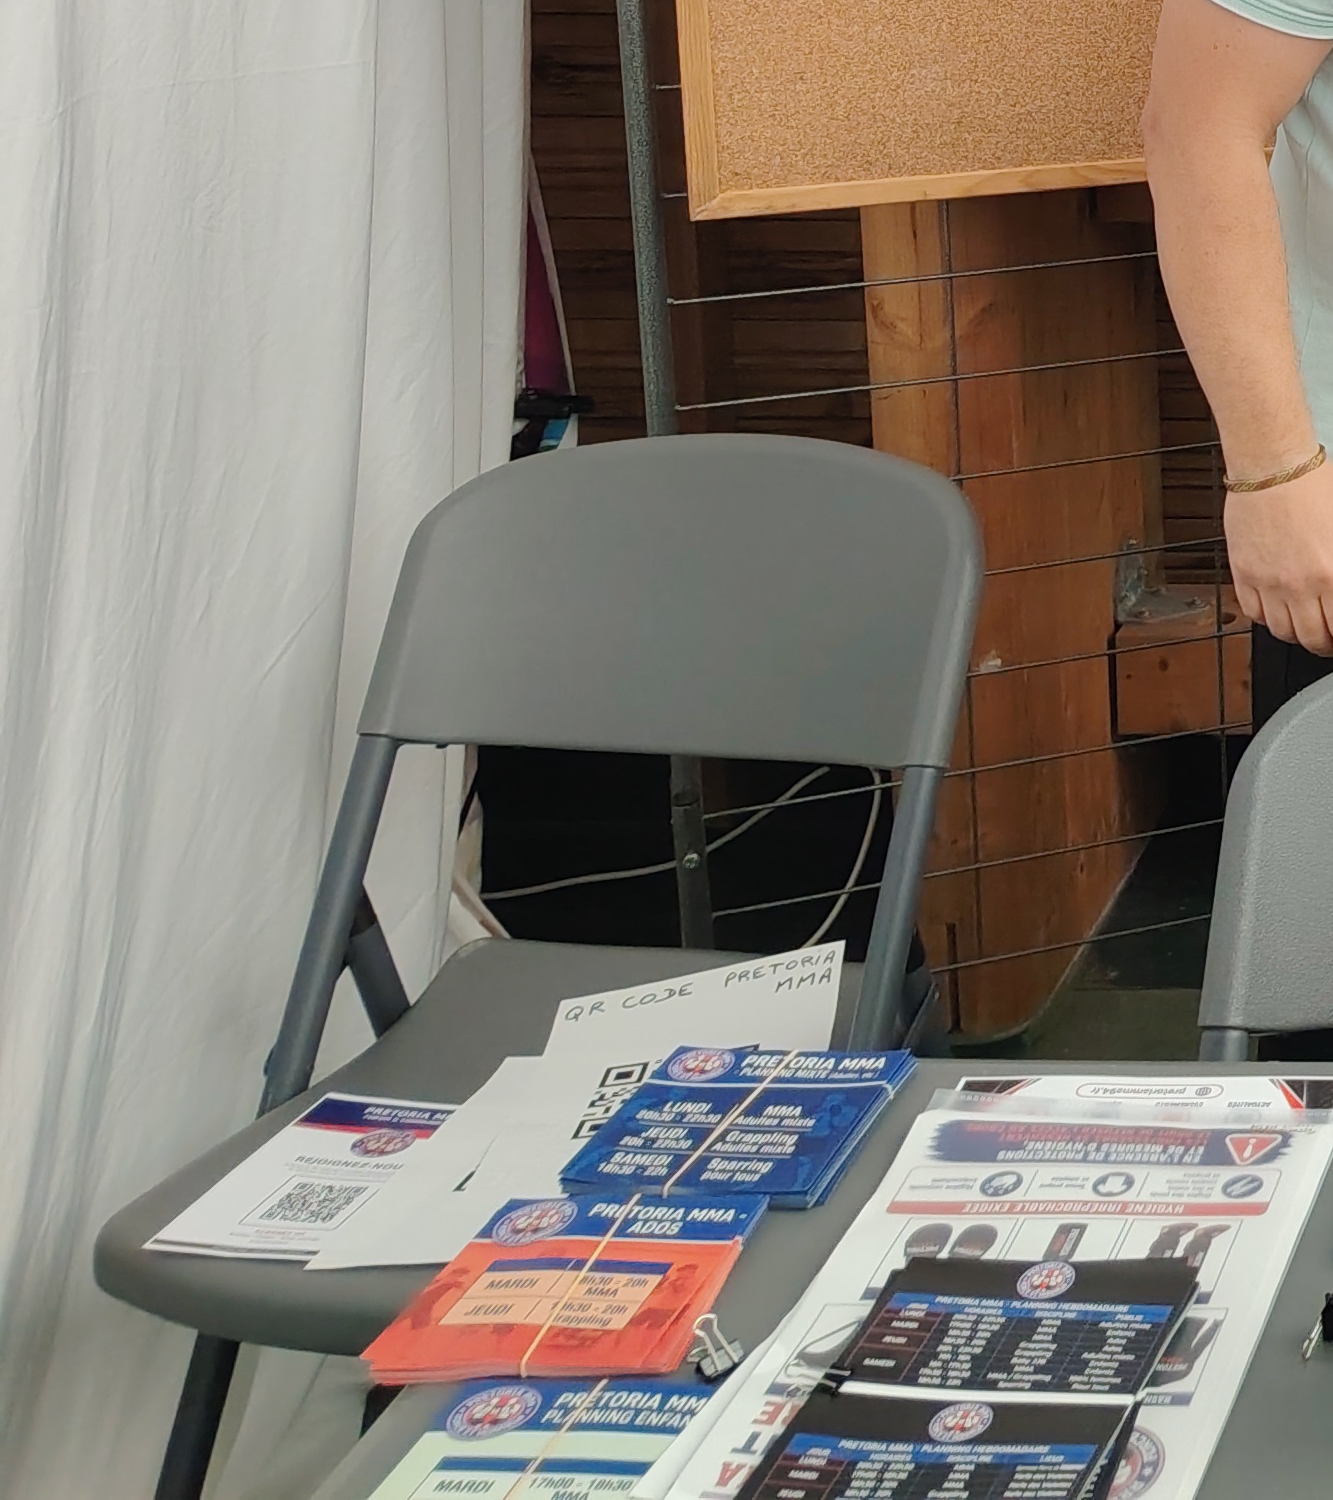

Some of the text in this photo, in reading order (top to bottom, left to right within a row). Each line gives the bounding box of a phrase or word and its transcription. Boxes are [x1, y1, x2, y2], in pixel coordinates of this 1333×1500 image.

[564, 949, 837, 1022] QR CODE PRETORIA
[774, 967, 833, 994] MMA
[837, 1056, 887, 1071] MMA
[663, 1101, 713, 1113] LUNDI
[763, 1105, 803, 1118] MMA
[641, 1127, 689, 1140] JEUDI
[725, 1131, 799, 1145] Grappling
[610, 1152, 673, 1166] SAMEDI
[706, 1158, 773, 1173] Sparring
[686, 1208, 736, 1223] MMA
[626, 1220, 683, 1236] ADOS
[484, 1277, 540, 1291] MARDI
[582, 1287, 619, 1299] MMA
[464, 1303, 515, 1317] JEUDI
[553, 1391, 661, 1410] PRETORIA
[432, 1479, 496, 1494] MARDI
